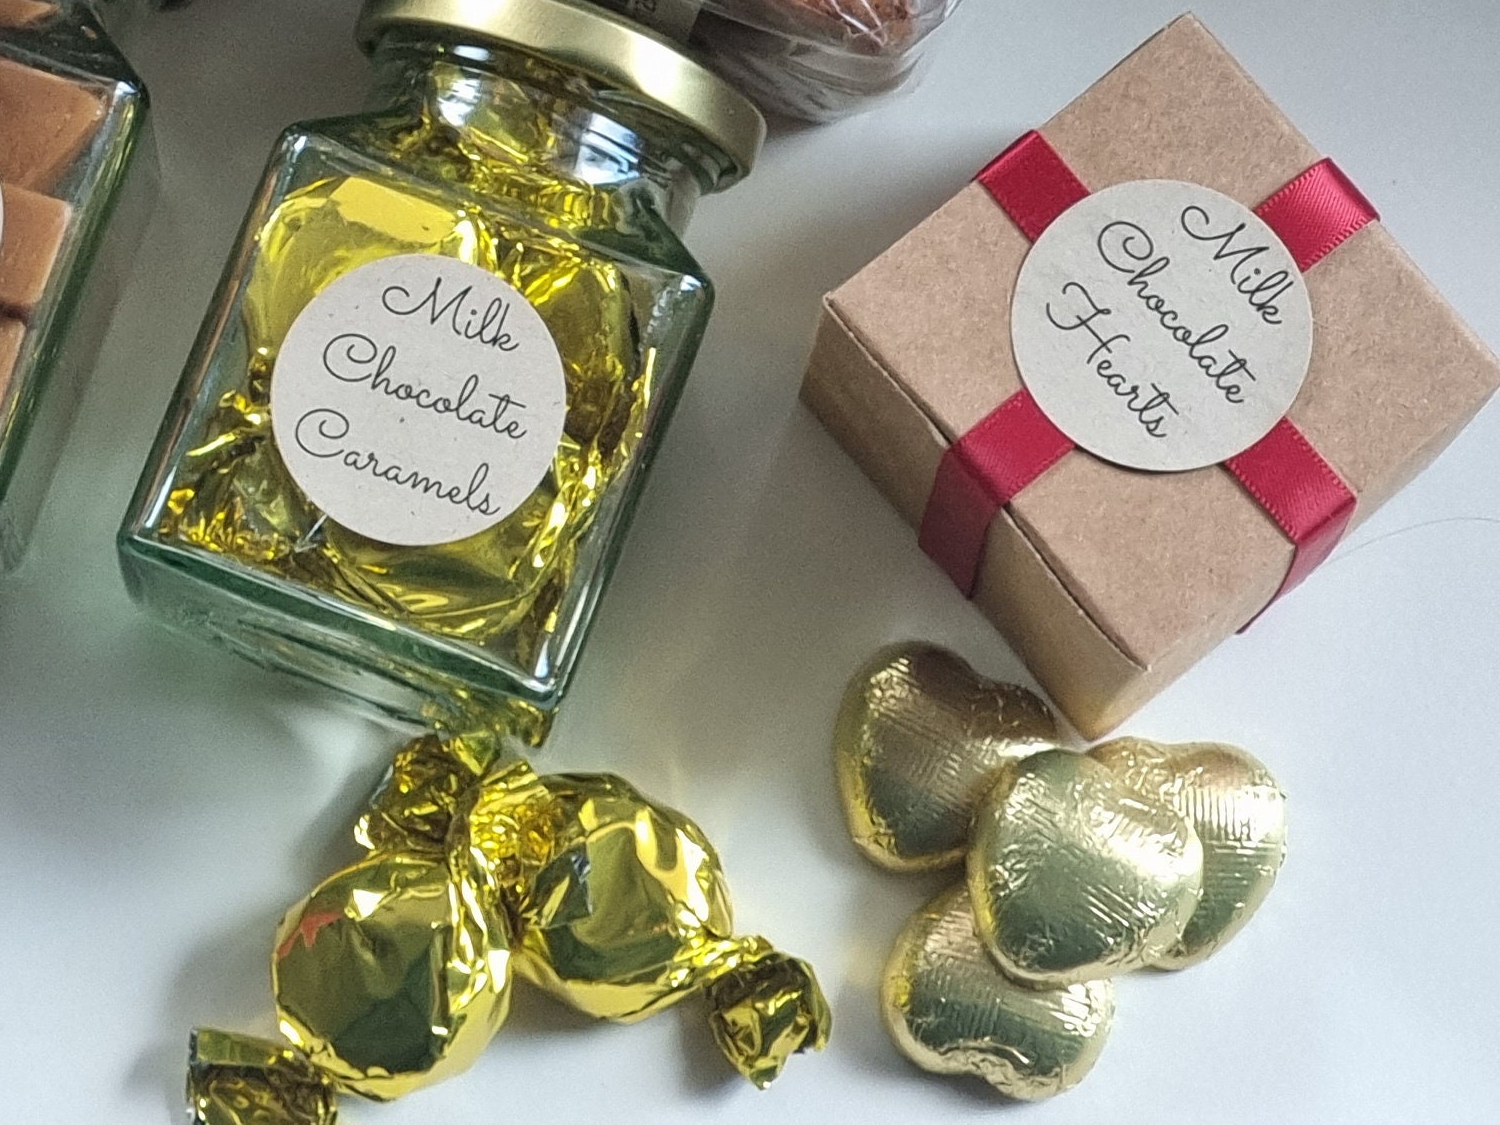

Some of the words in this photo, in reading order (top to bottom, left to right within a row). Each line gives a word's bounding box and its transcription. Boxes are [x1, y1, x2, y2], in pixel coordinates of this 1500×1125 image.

[382, 276, 520, 352] Milk
[1097, 221, 1256, 404] Chocolate
[1181, 205, 1294, 325] Milk
[323, 333, 527, 440] Chocolate
[1046, 281, 1180, 438] Hearts
[295, 408, 501, 516] Caramels
